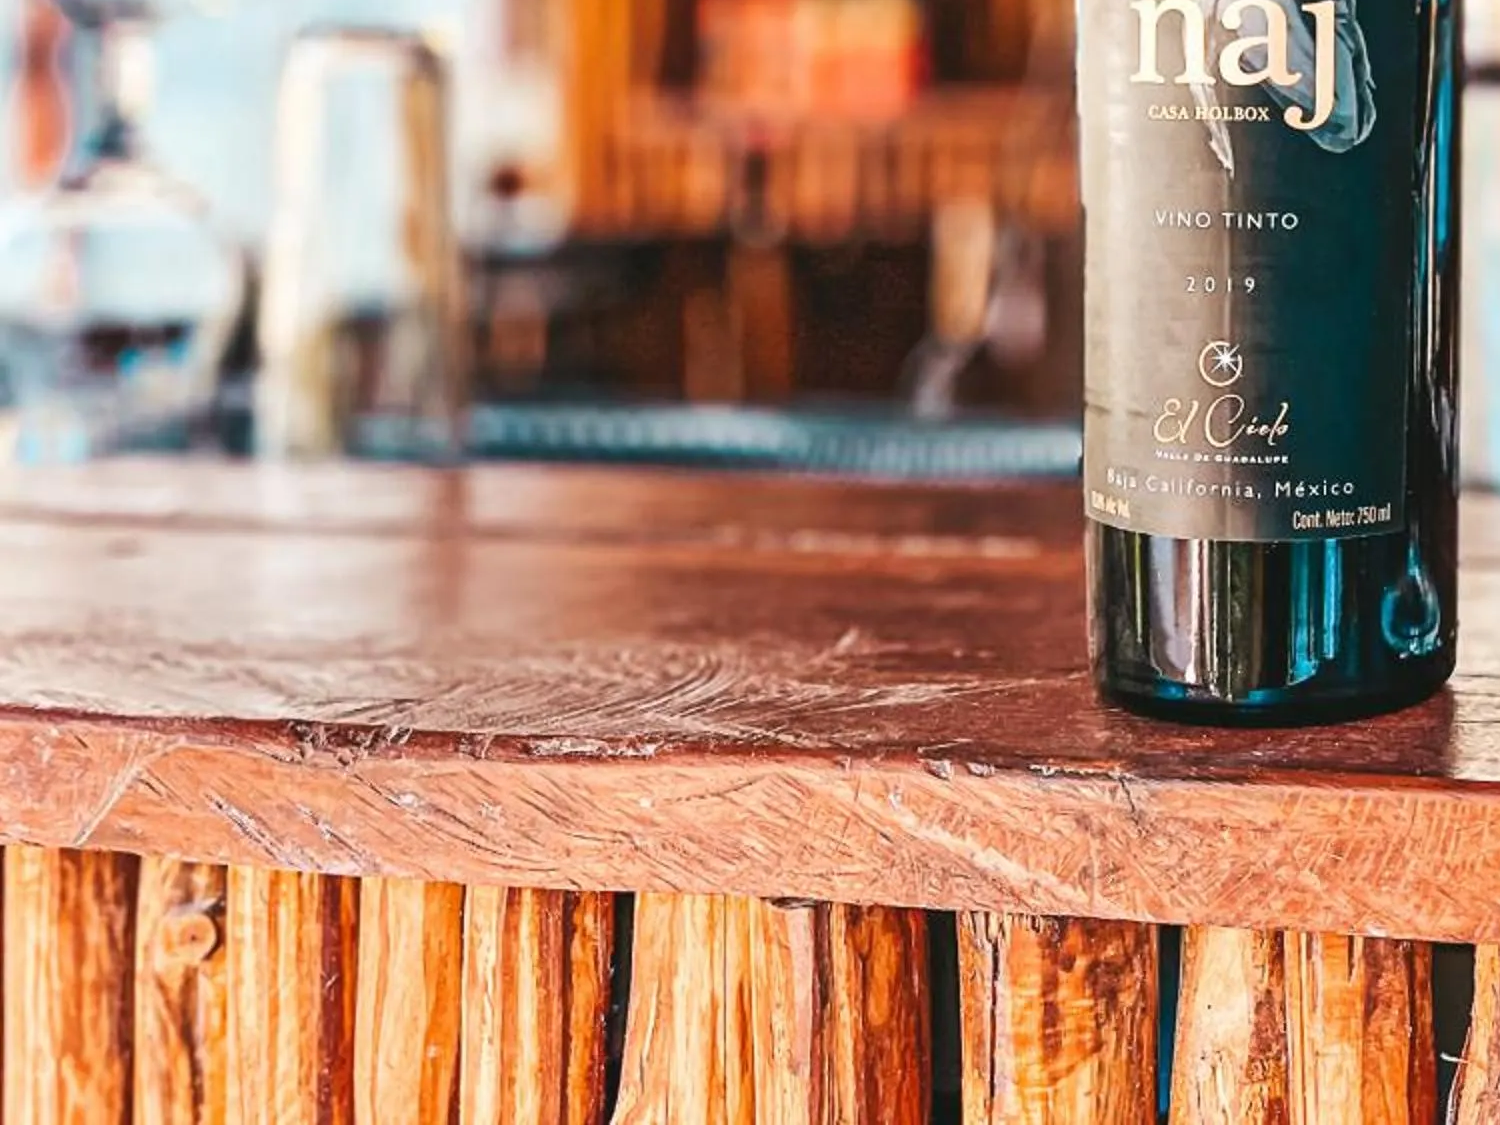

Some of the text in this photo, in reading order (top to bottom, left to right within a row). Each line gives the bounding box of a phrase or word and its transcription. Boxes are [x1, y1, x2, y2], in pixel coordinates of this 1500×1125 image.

[1148, 105, 1270, 122] CASA HOLBOX
[1154, 210, 1299, 230] VINO TINTO
[1186, 276, 1256, 293] 2019
[1153, 394, 1290, 448] El Cielo
[1214, 454, 1289, 464] GUADALUPE
[1107, 467, 1355, 499] Baja California, México
[1293, 510, 1323, 530] Cont.
